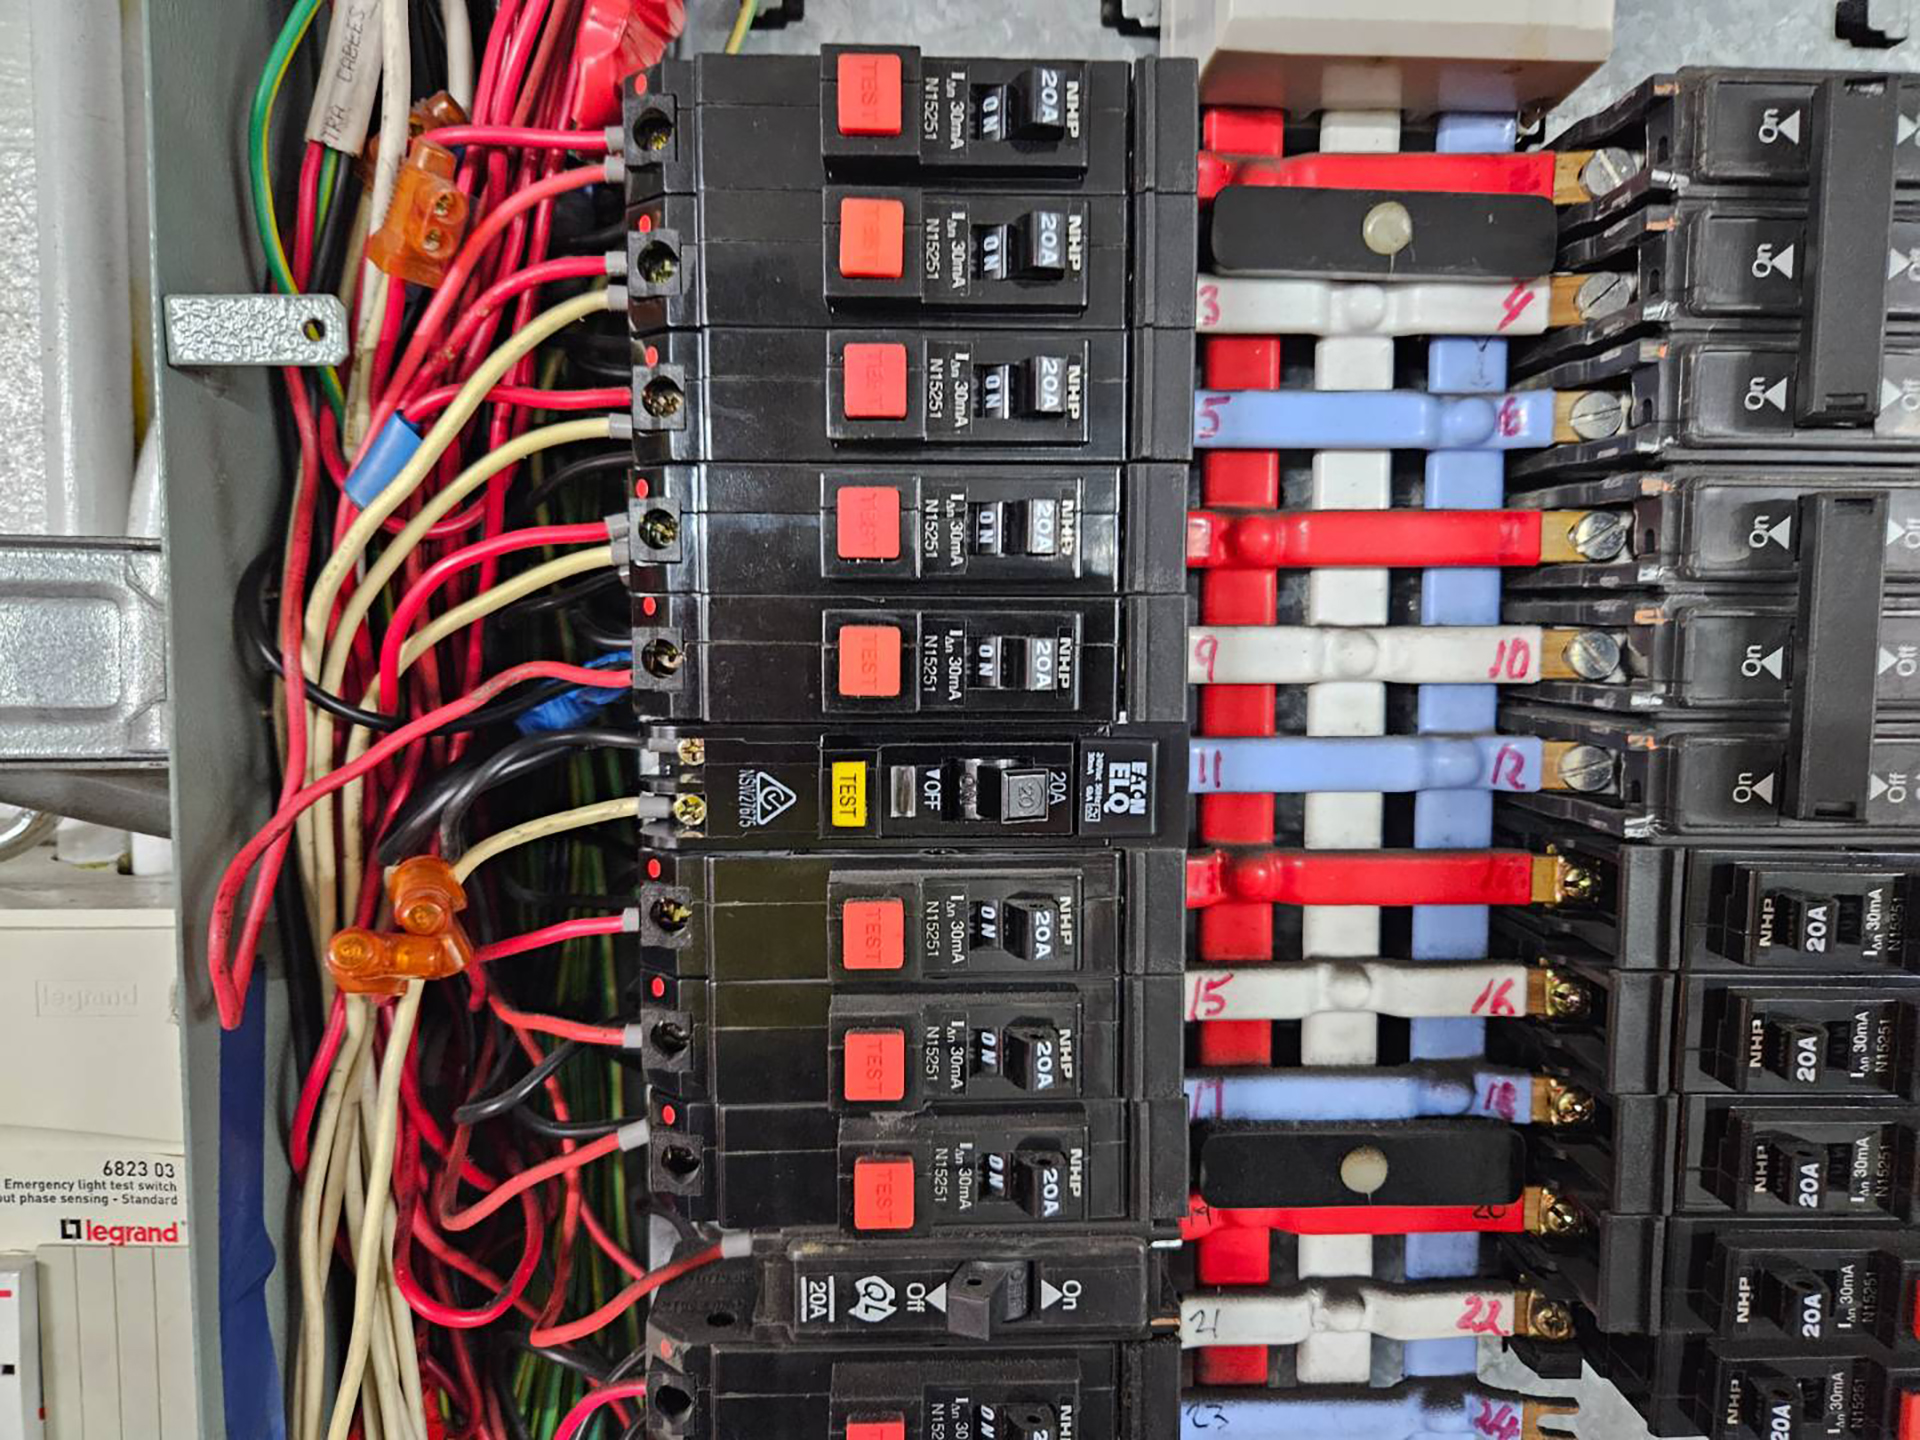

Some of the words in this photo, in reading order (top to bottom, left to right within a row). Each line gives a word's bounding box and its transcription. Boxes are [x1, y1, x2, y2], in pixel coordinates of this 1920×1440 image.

[925, 78, 939, 140] N15251
[982, 95, 998, 133] ON
[1041, 70, 1058, 122] 20A
[1067, 81, 1079, 138] NHP
[950, 101, 965, 150] 30mA
[1758, 108, 1778, 143] On
[926, 218, 939, 280] N15251
[983, 236, 998, 271] ON
[1041, 213, 1057, 265] 20A
[1069, 215, 1081, 271] NHP
[1752, 243, 1772, 278] On
[951, 240, 965, 289] 30mA
[1199, 284, 1220, 326] 3
[929, 358, 943, 419] N15251
[955, 380, 968, 427] 30mA
[986, 374, 1001, 408] ON
[1043, 359, 1058, 408] 20A
[1067, 364, 1080, 419] NHP
[1744, 376, 1765, 410] On
[1199, 396, 1230, 439] 5
[1499, 396, 1522, 438] 6
[925, 499, 939, 558] N15251
[950, 520, 964, 566] 30mA
[979, 511, 994, 543] ON
[1035, 501, 1050, 551] 20A
[1061, 499, 1073, 555] NHP
[1749, 515, 1770, 548] On
[861, 634, 877, 690] TEST
[923, 635, 938, 692] N15251
[948, 656, 962, 700] 30mA
[979, 645, 994, 677] ON
[1036, 640, 1052, 689] 20A
[1058, 637, 1072, 688] NHP
[1195, 635, 1219, 682] 9
[1488, 637, 1530, 680] 10
[1741, 645, 1762, 677] On
[1896, 645, 1918, 676] Off
[839, 773, 856, 818] TEST
[924, 781, 940, 811] OFF
[1050, 771, 1067, 806] 20A
[1103, 763, 1130, 814] ELQ
[1129, 762, 1147, 815] EATON
[1733, 772, 1752, 803] On
[1887, 772, 1907, 803] Off
[926, 901, 940, 957] N15251
[981, 906, 996, 938] ON
[1060, 896, 1072, 945] NHP
[1759, 898, 1775, 946] NHP
[1806, 906, 1827, 953] 20A
[1866, 888, 1883, 931] 30mA
[865, 909, 881, 962] TEST
[951, 919, 965, 964] 30mA
[1035, 911, 1050, 959] 20A
[43, 984, 138, 1011] legrand
[1190, 972, 1234, 1021] 15
[926, 1026, 939, 1081] N15251
[981, 1032, 996, 1065] ON
[1059, 1029, 1072, 1078] NHP
[1750, 1019, 1764, 1067] NHP
[1853, 1011, 1870, 1053] 30mA
[1875, 1019, 1892, 1072] N15251
[867, 1041, 882, 1094] TEST
[951, 1046, 964, 1090] 30mA
[1037, 1041, 1052, 1090] 20A
[1797, 1036, 1818, 1082] 20A
[103, 1160, 149, 1178] 6823
[154, 1162, 175, 1179] 03
[935, 1148, 948, 1202] N15251
[989, 1154, 1004, 1190] ON
[1070, 1148, 1083, 1196] NHP
[1754, 1145, 1769, 1193] NHP
[1854, 1136, 1870, 1178] 30mA
[4, 1179, 75, 1192] Emergency
[78, 1179, 107, 1192] light
[110, 1180, 134, 1191] test
[138, 1180, 177, 1192] switch
[19, 1193, 57, 1206] phase
[60, 1193, 109, 1206] sensing
[121, 1193, 178, 1206] Standard
[876, 1171, 892, 1223] TEST
[959, 1167, 973, 1210] 30mA
[1043, 1168, 1059, 1216] 20A
[1800, 1163, 1820, 1208] 20A
[86, 1219, 180, 1246] legrand
[809, 1281, 827, 1318] 20A
[862, 1281, 888, 1315] QL
[907, 1282, 926, 1313] Off
[1062, 1280, 1082, 1311] On
[1737, 1276, 1751, 1323] NHP
[1840, 1264, 1855, 1305] 30mA
[1802, 1293, 1822, 1338] 20A
[1727, 1380, 1740, 1425] NHP
[1830, 1371, 1845, 1412] 30mA
[980, 1405, 994, 1437] ON
[1771, 1404, 1791, 1440] 20A
